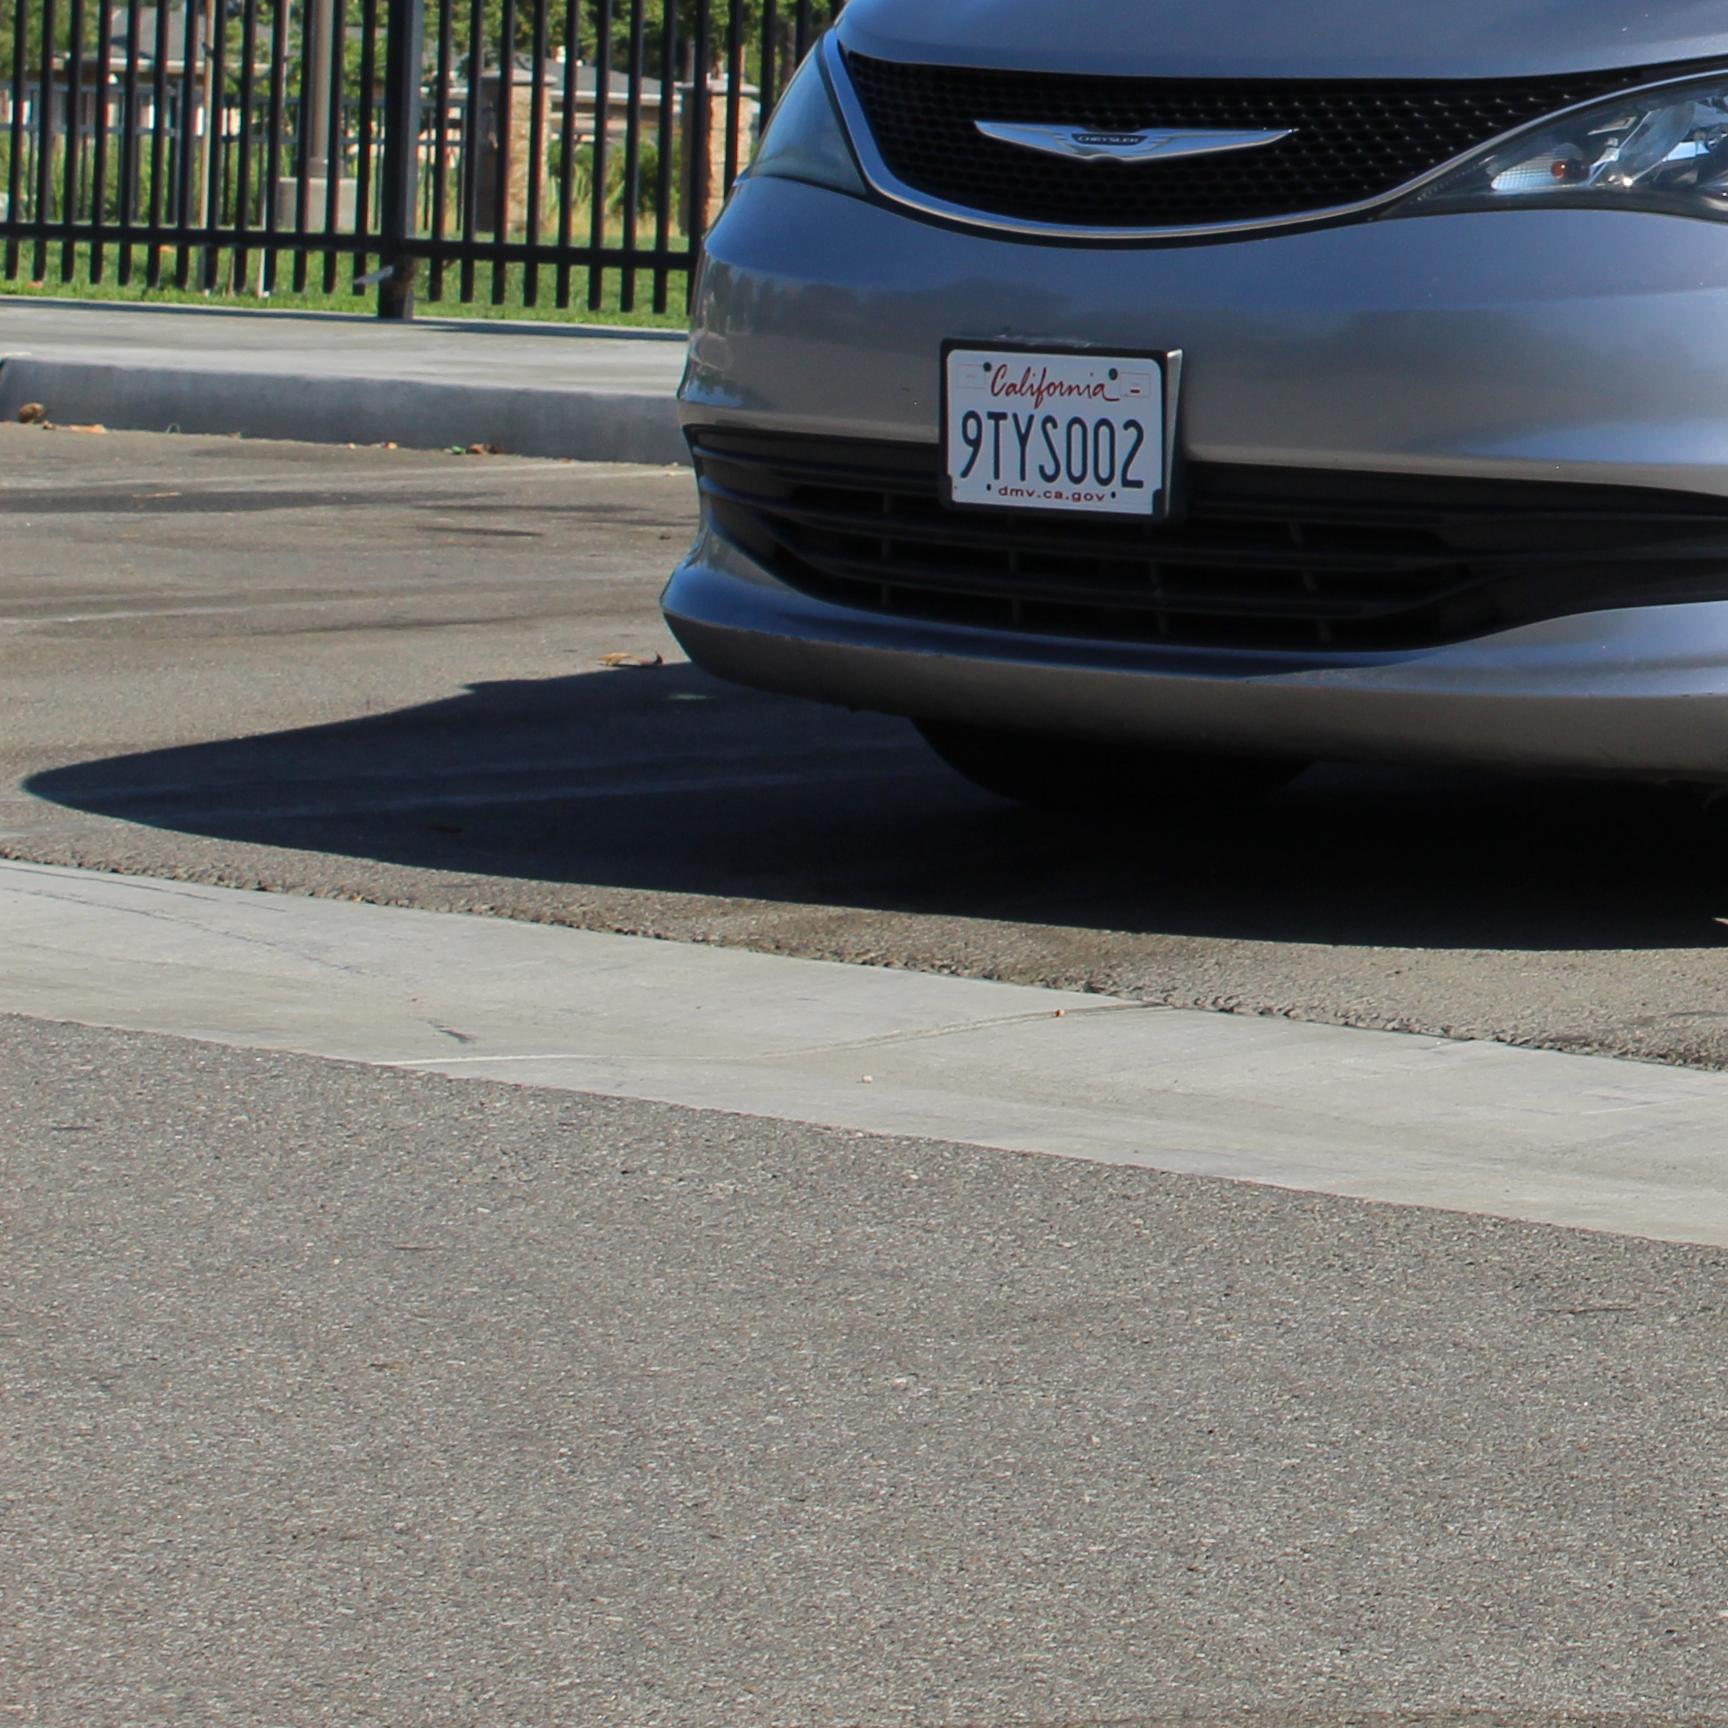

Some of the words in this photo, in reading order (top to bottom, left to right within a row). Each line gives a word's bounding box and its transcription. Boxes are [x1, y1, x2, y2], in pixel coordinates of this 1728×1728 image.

[990, 364, 1120, 409] California
[960, 410, 1144, 489] 9TYS002
[998, 485, 1105, 502] dmv.ca.gov
